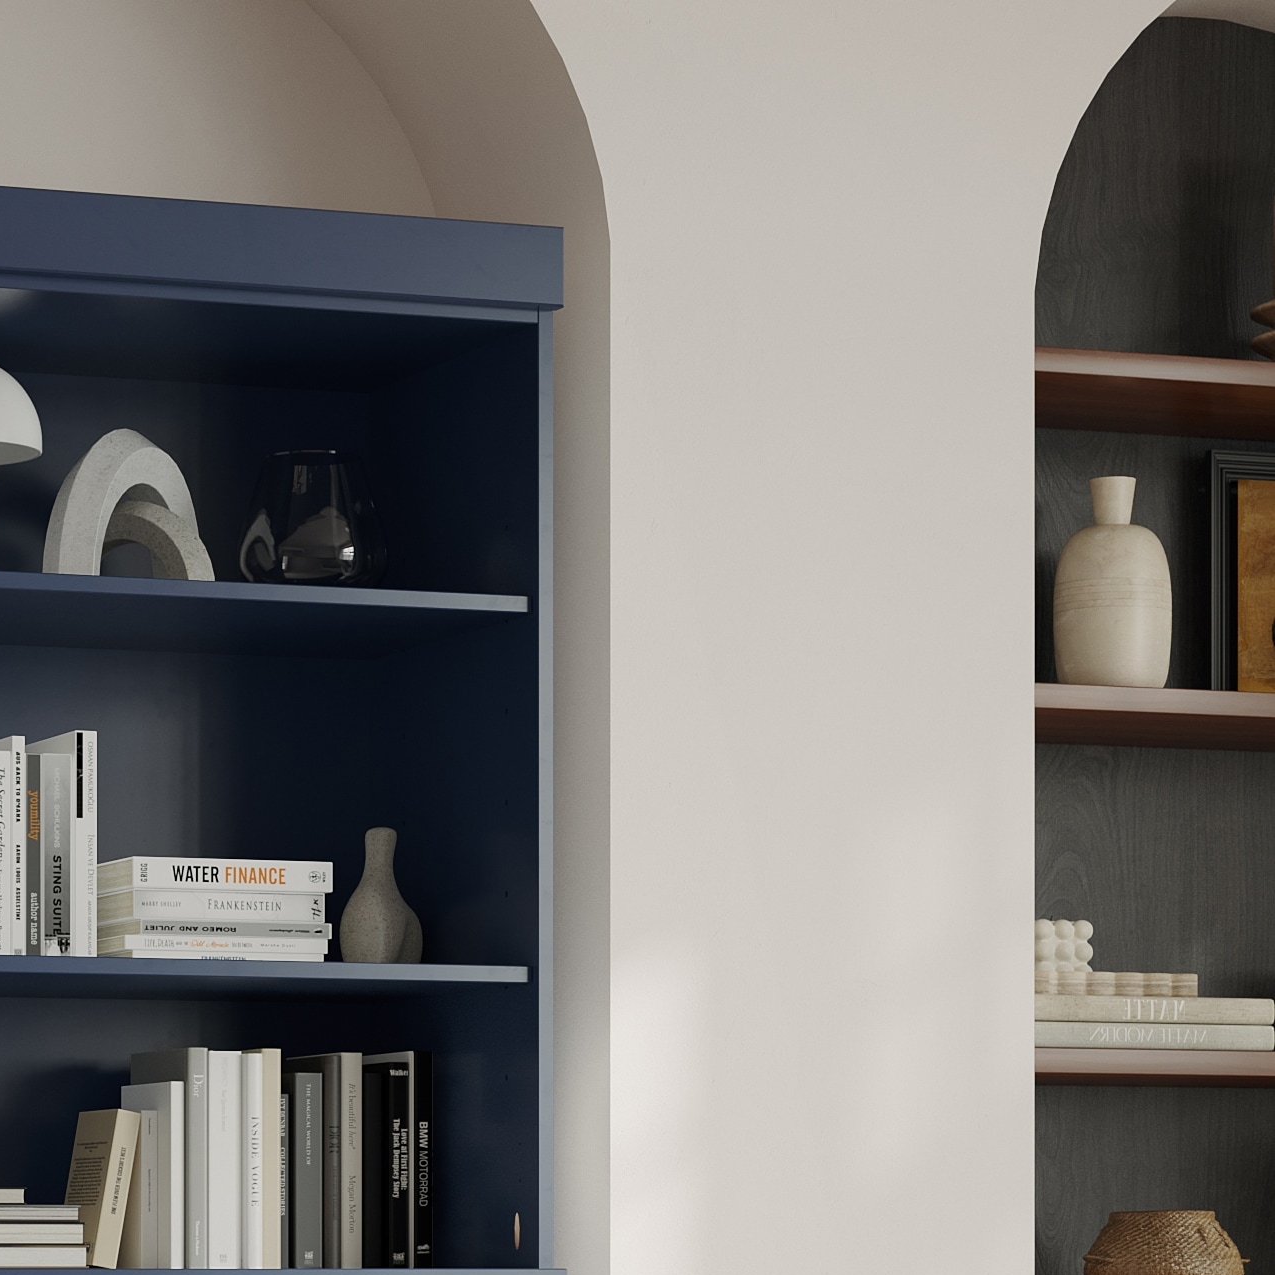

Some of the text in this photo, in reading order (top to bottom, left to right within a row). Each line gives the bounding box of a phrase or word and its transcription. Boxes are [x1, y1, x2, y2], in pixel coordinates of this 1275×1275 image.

[16, 788, 21, 796] TO
[140, 863, 148, 883] GRIGG
[172, 865, 286, 885] WATER FINANCE
[53, 854, 62, 936] STING SUITE
[207, 899, 282, 911] FRANKENSTEIN
[31, 892, 39, 921] author
[193, 1074, 204, 1098] Dior
[392, 1118, 400, 1132] The
[392, 1133, 400, 1148] Jack
[400, 1128, 408, 1145] Love
[251, 1116, 259, 1207] INSIDE VOGUE
[305, 1156, 311, 1165] OF
[419, 1121, 429, 1207] BMW MOTORRAD
[391, 1181, 400, 1199] Story
[348, 1175, 356, 1234] Megan Morton
